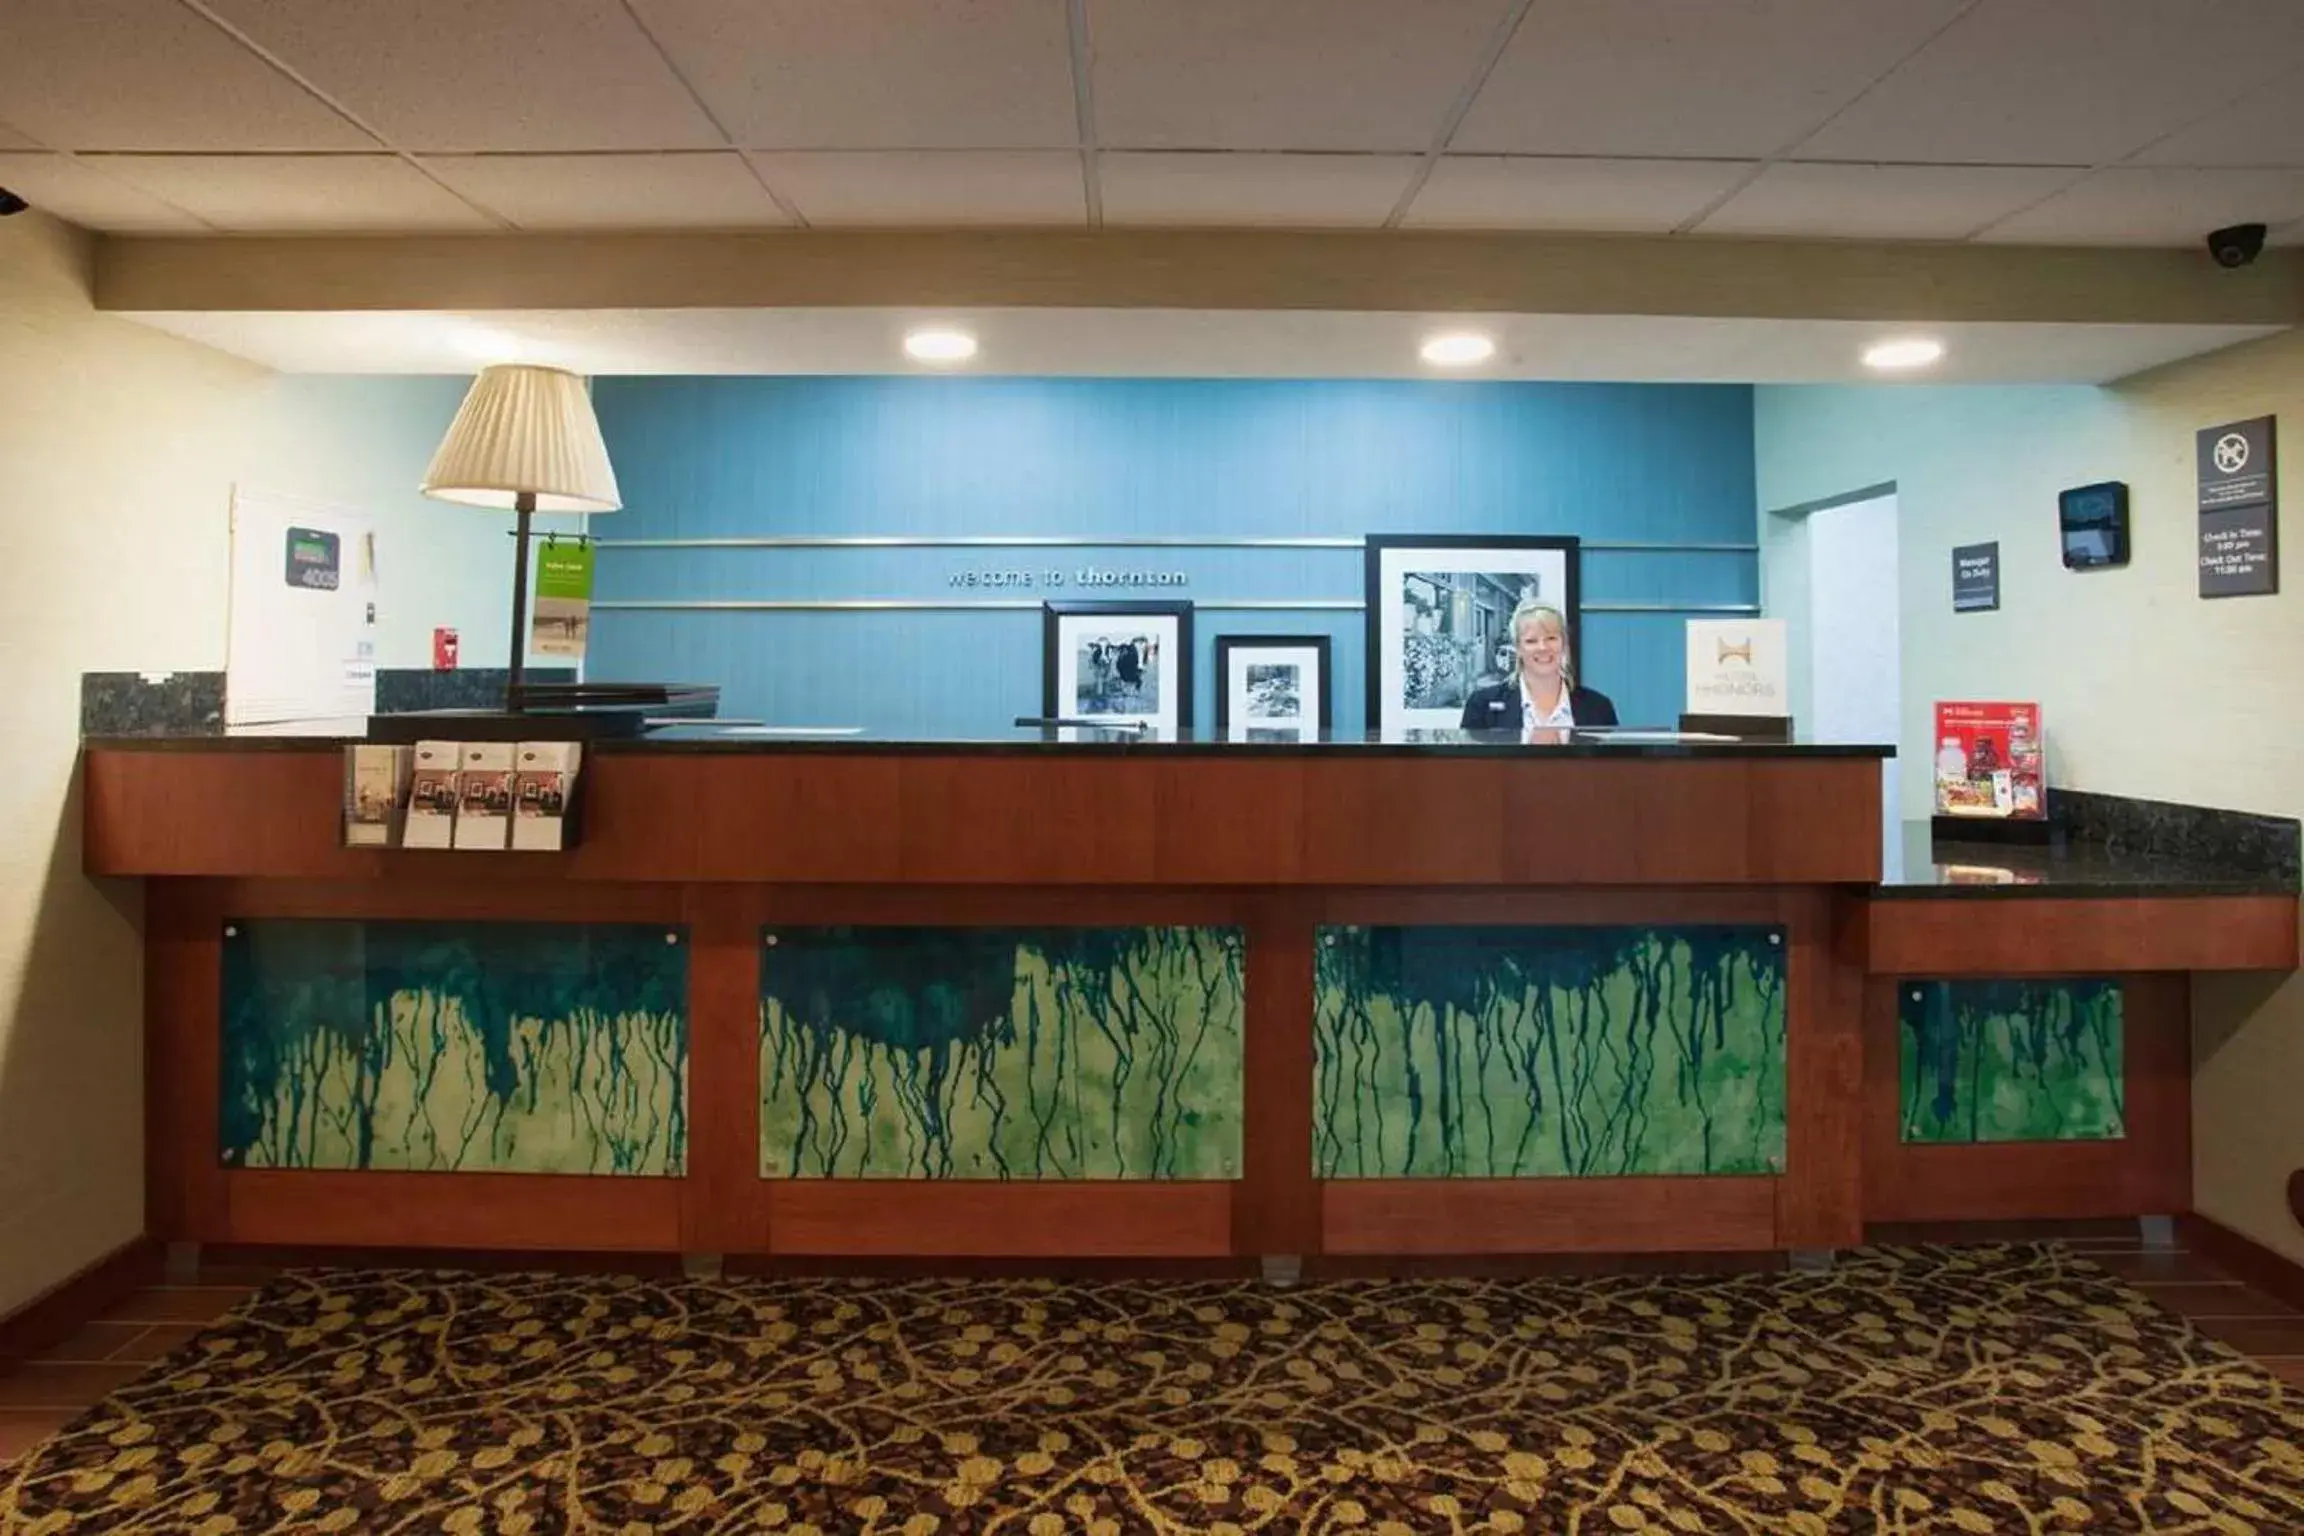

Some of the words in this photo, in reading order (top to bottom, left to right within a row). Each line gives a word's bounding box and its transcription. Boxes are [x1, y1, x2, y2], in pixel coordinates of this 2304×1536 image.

[948, 569, 1034, 588] wecome
[1043, 566, 1065, 587] to
[1076, 566, 1188, 587] thornton
